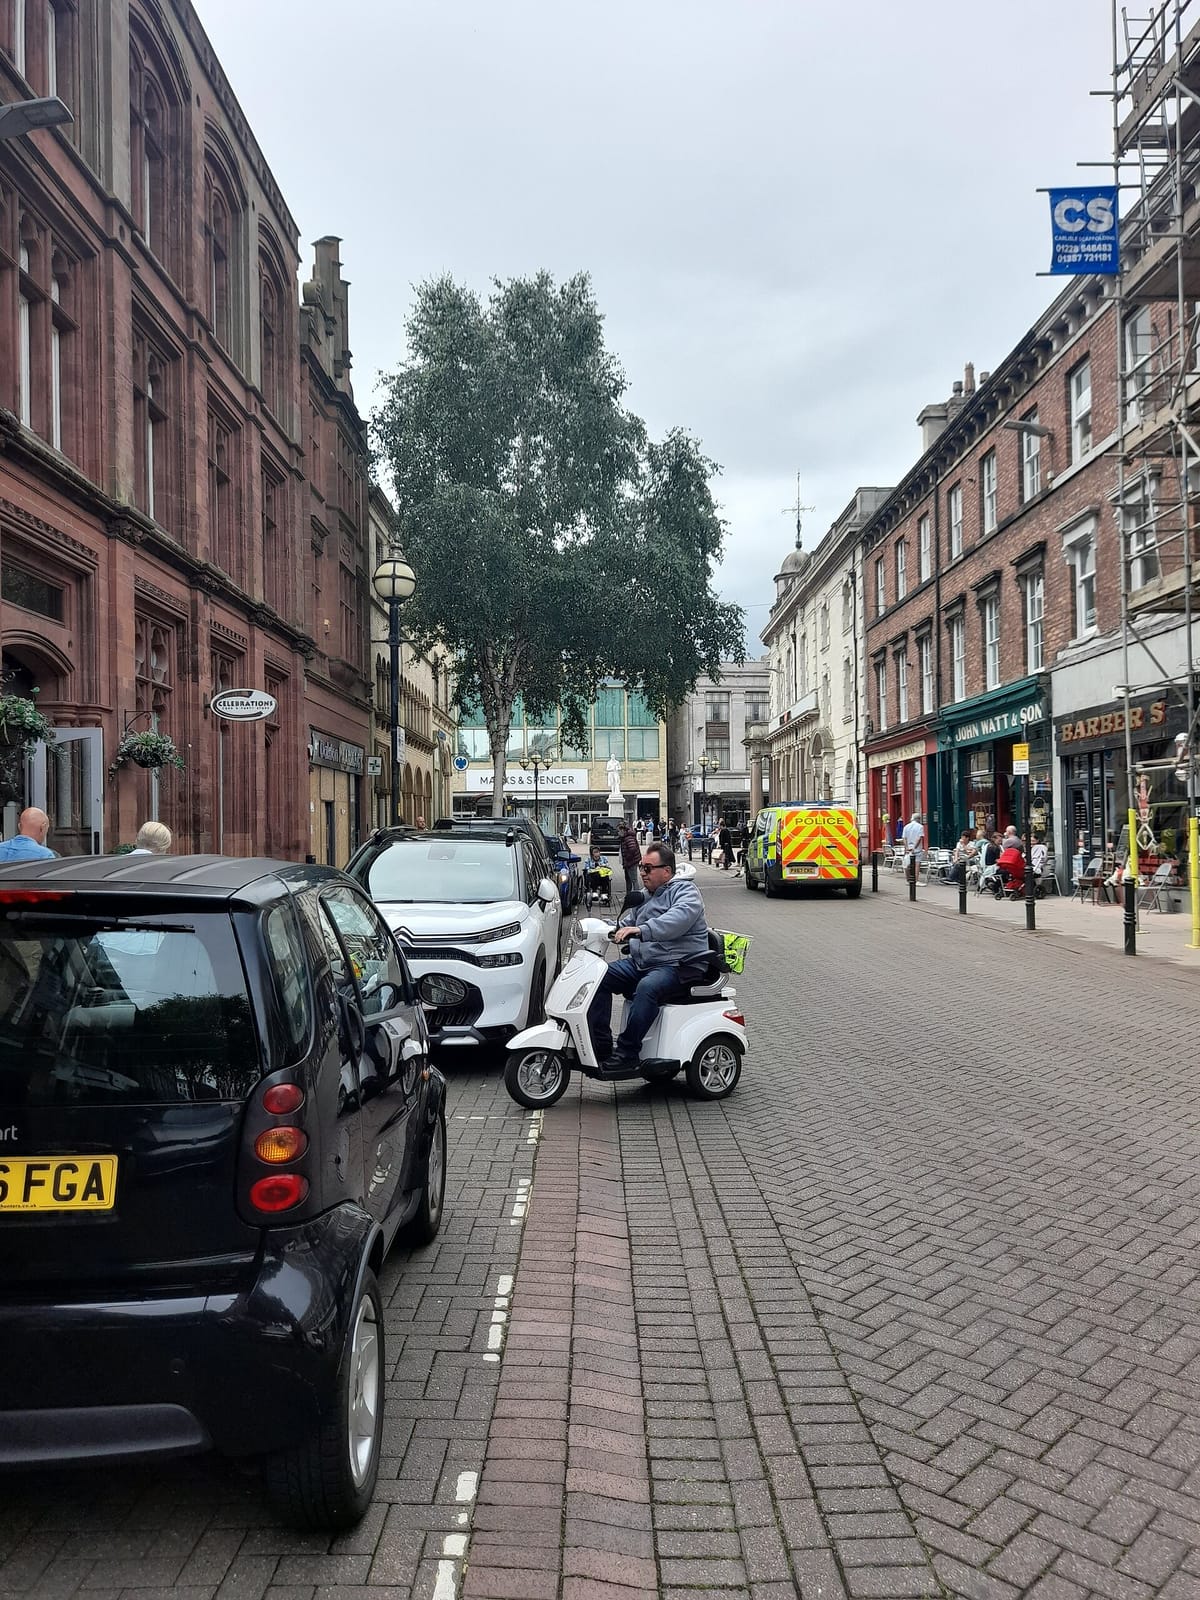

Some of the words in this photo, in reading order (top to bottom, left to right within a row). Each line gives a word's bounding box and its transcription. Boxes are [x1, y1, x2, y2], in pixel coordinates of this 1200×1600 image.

[1054, 197, 1114, 233] CS
[956, 722, 979, 742] JOHN
[981, 713, 1009, 735] WATT
[1011, 713, 1018, 727] &
[1020, 703, 1043, 725] SON
[518, 776, 524, 785] &
[795, 817, 845, 825] POLICE
[23, 1162, 105, 1203] FGA
